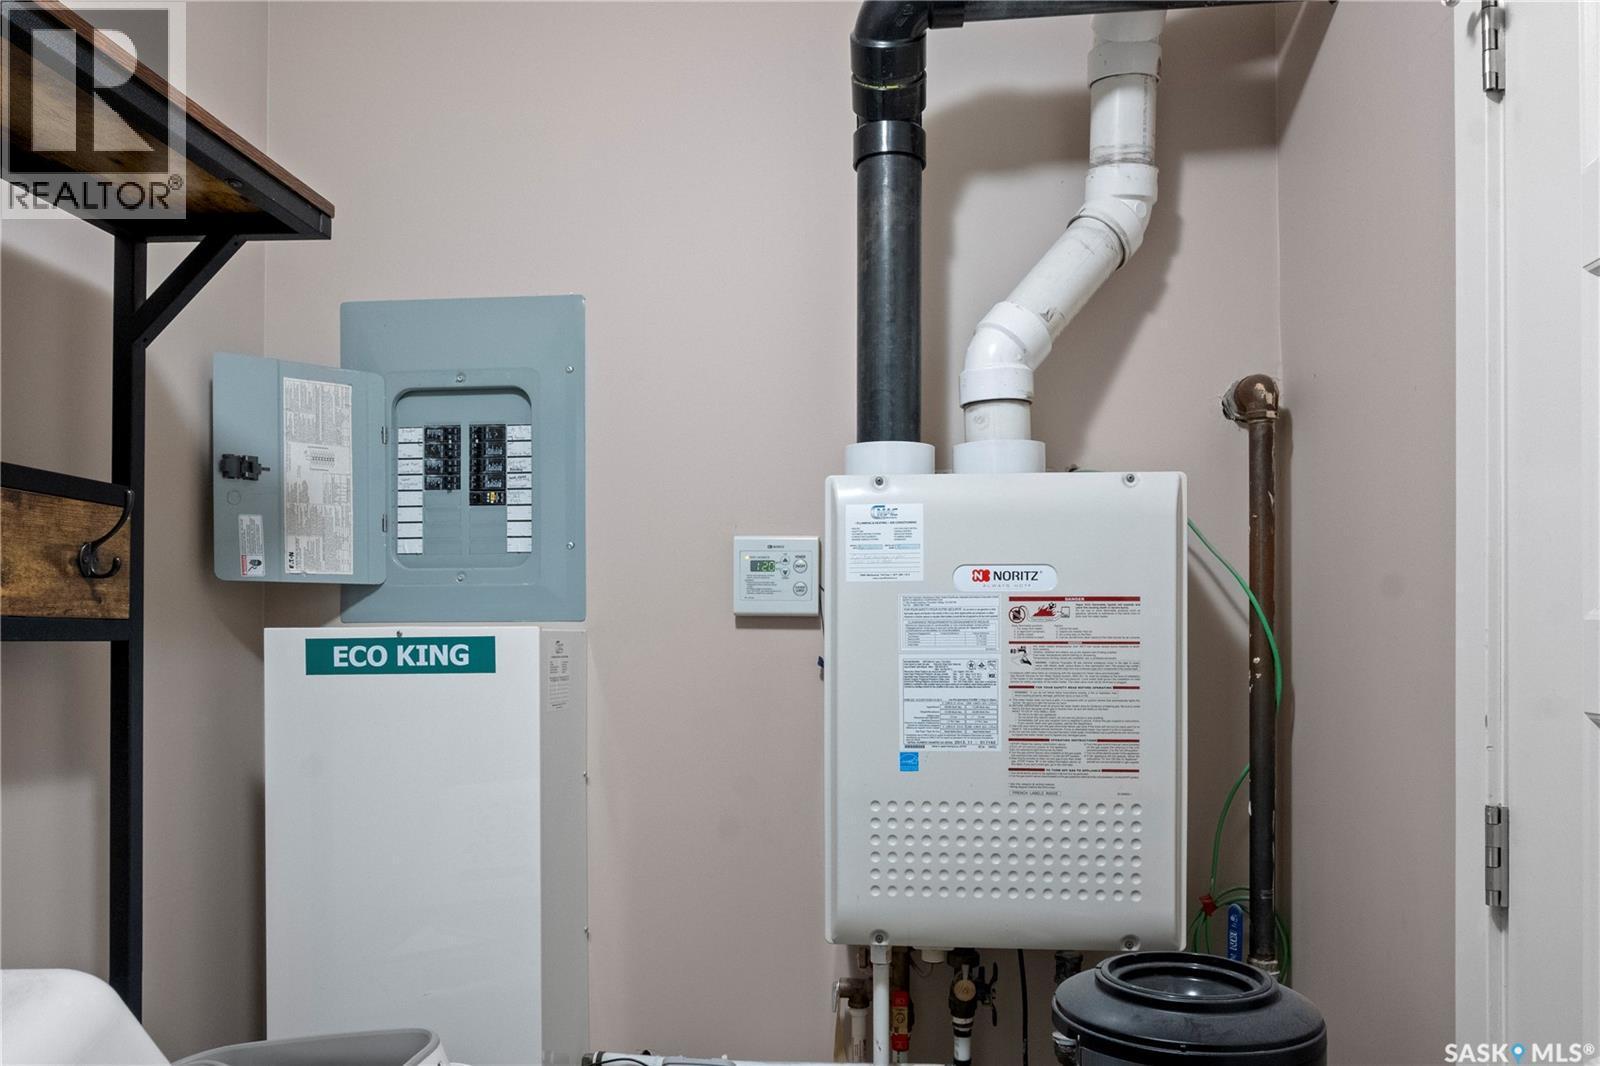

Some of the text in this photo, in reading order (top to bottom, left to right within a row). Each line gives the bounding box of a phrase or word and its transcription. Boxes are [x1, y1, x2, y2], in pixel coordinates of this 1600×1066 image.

[993, 571, 1039, 581] NORITZ
[333, 644, 470, 668] ECO KING
